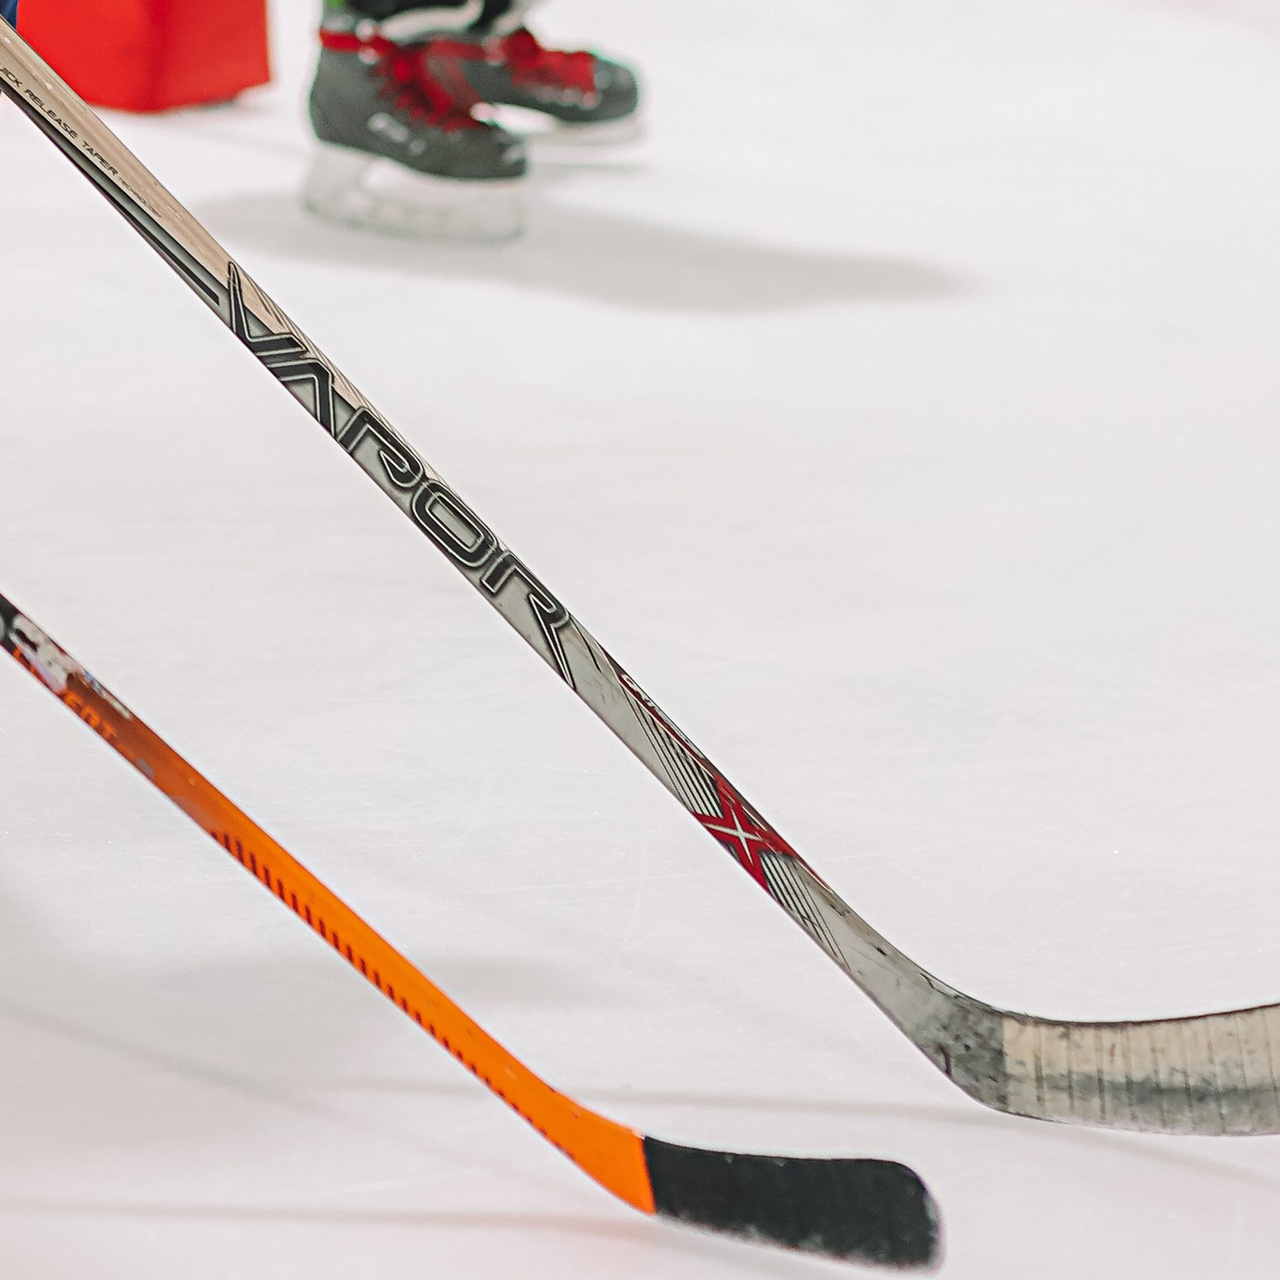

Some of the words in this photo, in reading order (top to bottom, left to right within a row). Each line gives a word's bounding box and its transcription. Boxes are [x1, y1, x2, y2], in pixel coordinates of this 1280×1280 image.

[24, 89, 79, 139] RELEASE
[82, 140, 119, 176] TAPER
[227, 261, 579, 694] VAPOR
